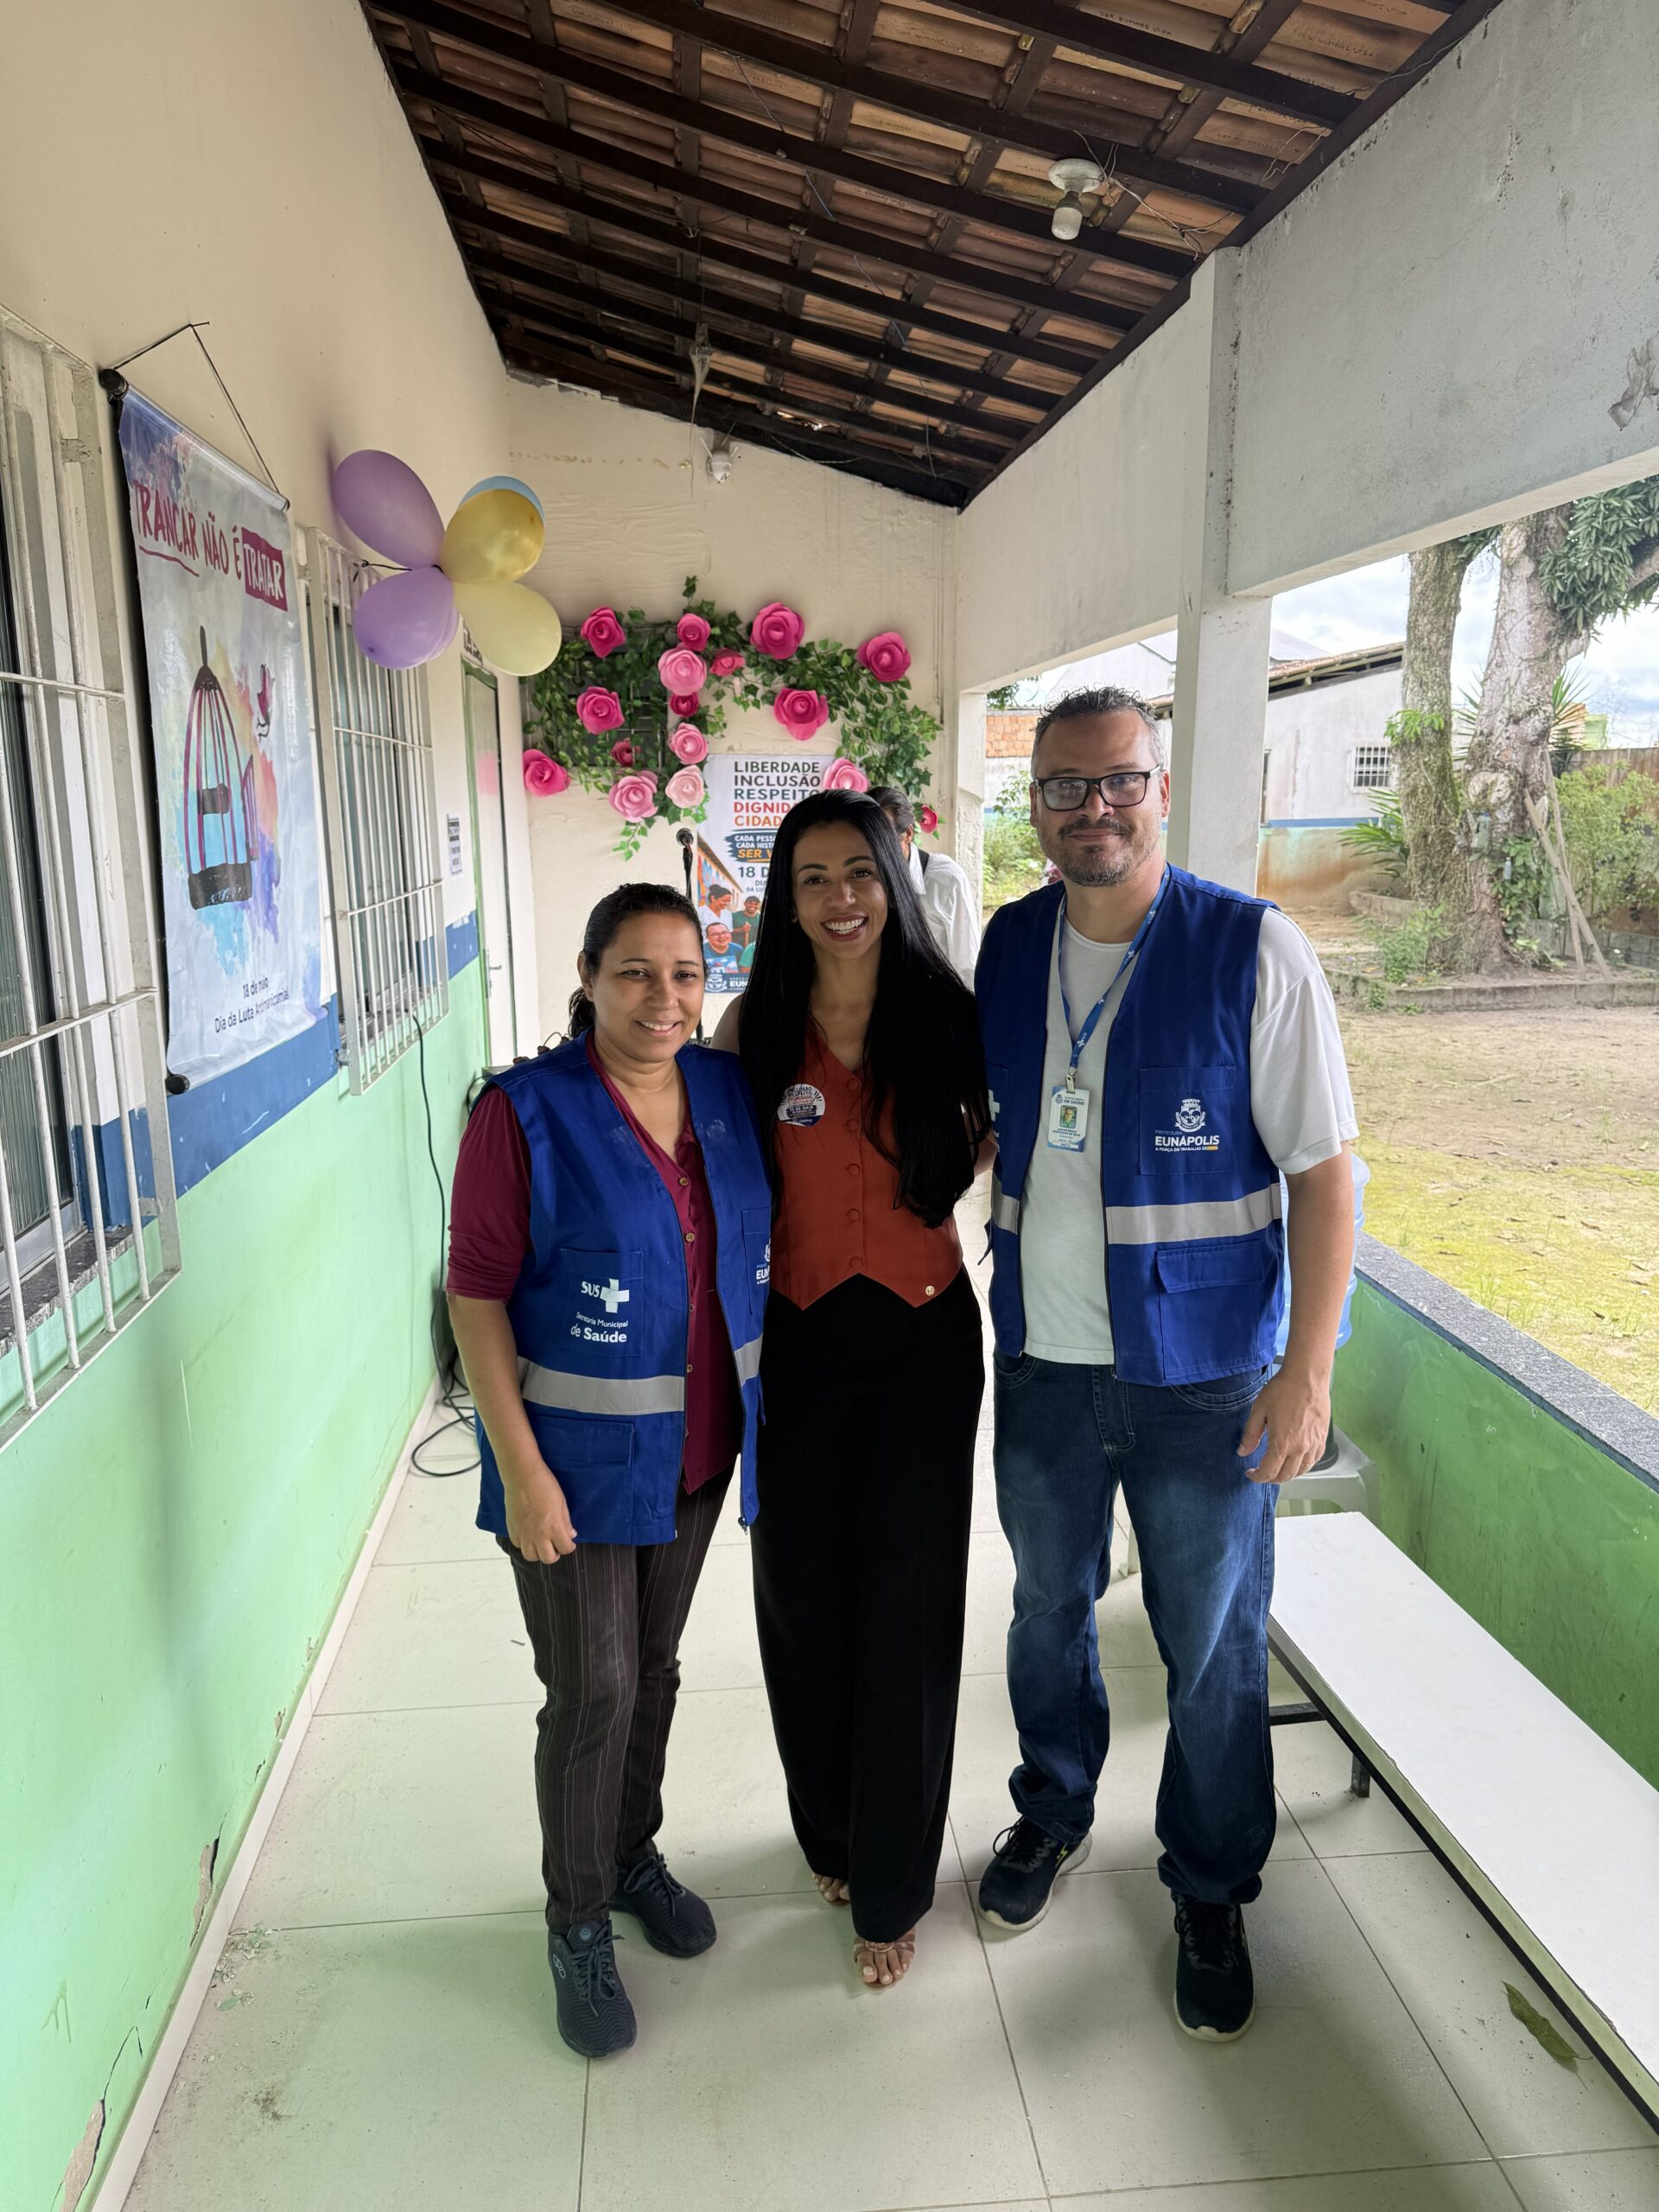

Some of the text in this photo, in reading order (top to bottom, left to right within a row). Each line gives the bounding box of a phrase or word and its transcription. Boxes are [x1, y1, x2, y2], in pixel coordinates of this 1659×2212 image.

[133, 479, 283, 600] TRANCAR NÃO É TRATAR
[734, 761, 820, 773] LIBERDADE
[734, 773, 821, 787] INCLUSÃO
[738, 849, 762, 858] SER
[738, 866, 755, 878] 18
[214, 1015, 226, 1033] Dia
[227, 1011, 237, 1027] da
[238, 1007, 254, 1023] Luta
[1154, 1135, 1220, 1147] EUNÁPOLIS
[581, 1281, 601, 1298] SUS
[575, 1311, 628, 1329] Secretaria Municipal
[570, 1323, 627, 1344] de Saúde
